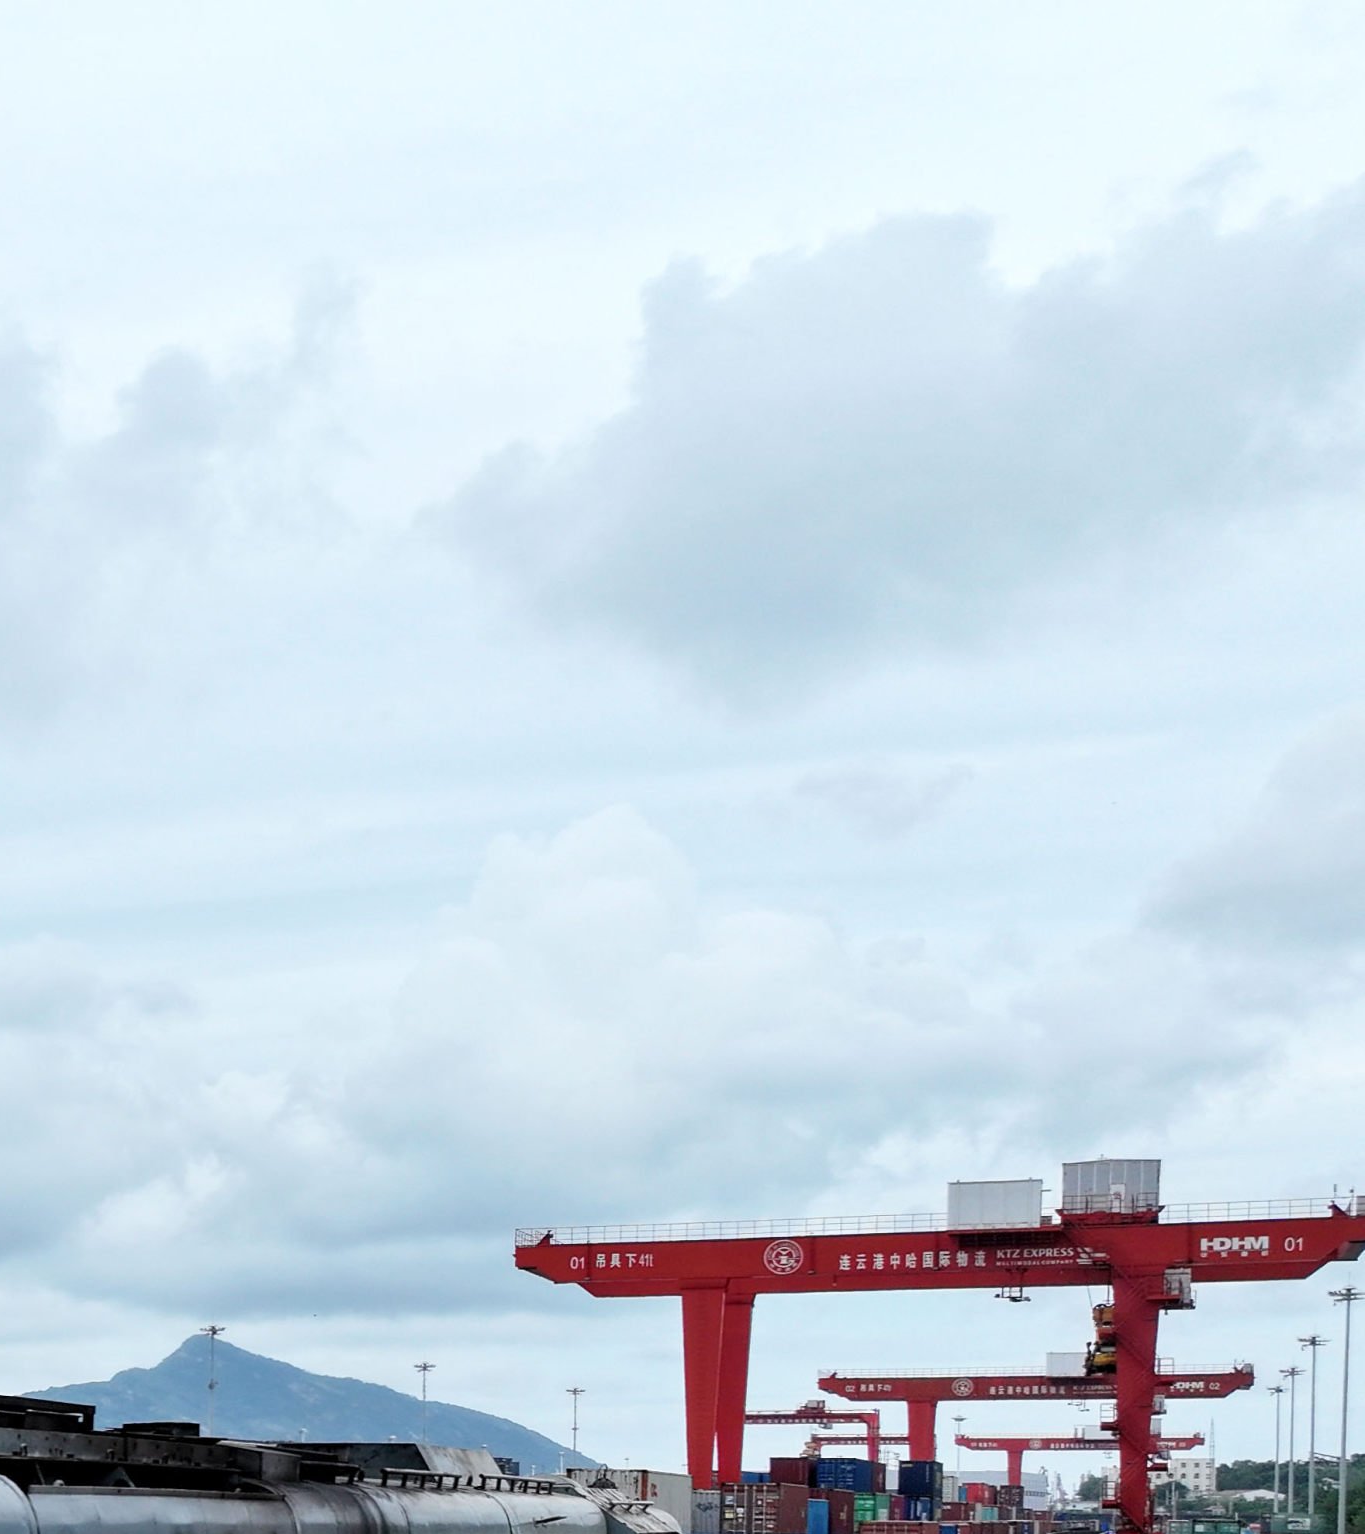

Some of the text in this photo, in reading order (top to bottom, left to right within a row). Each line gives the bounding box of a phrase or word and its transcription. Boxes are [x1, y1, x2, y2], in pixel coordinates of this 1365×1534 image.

[1284, 1237, 1304, 1252] 01
[996, 1247, 1075, 1260] KTZ EXPRESS
[569, 1256, 586, 1270] 01
